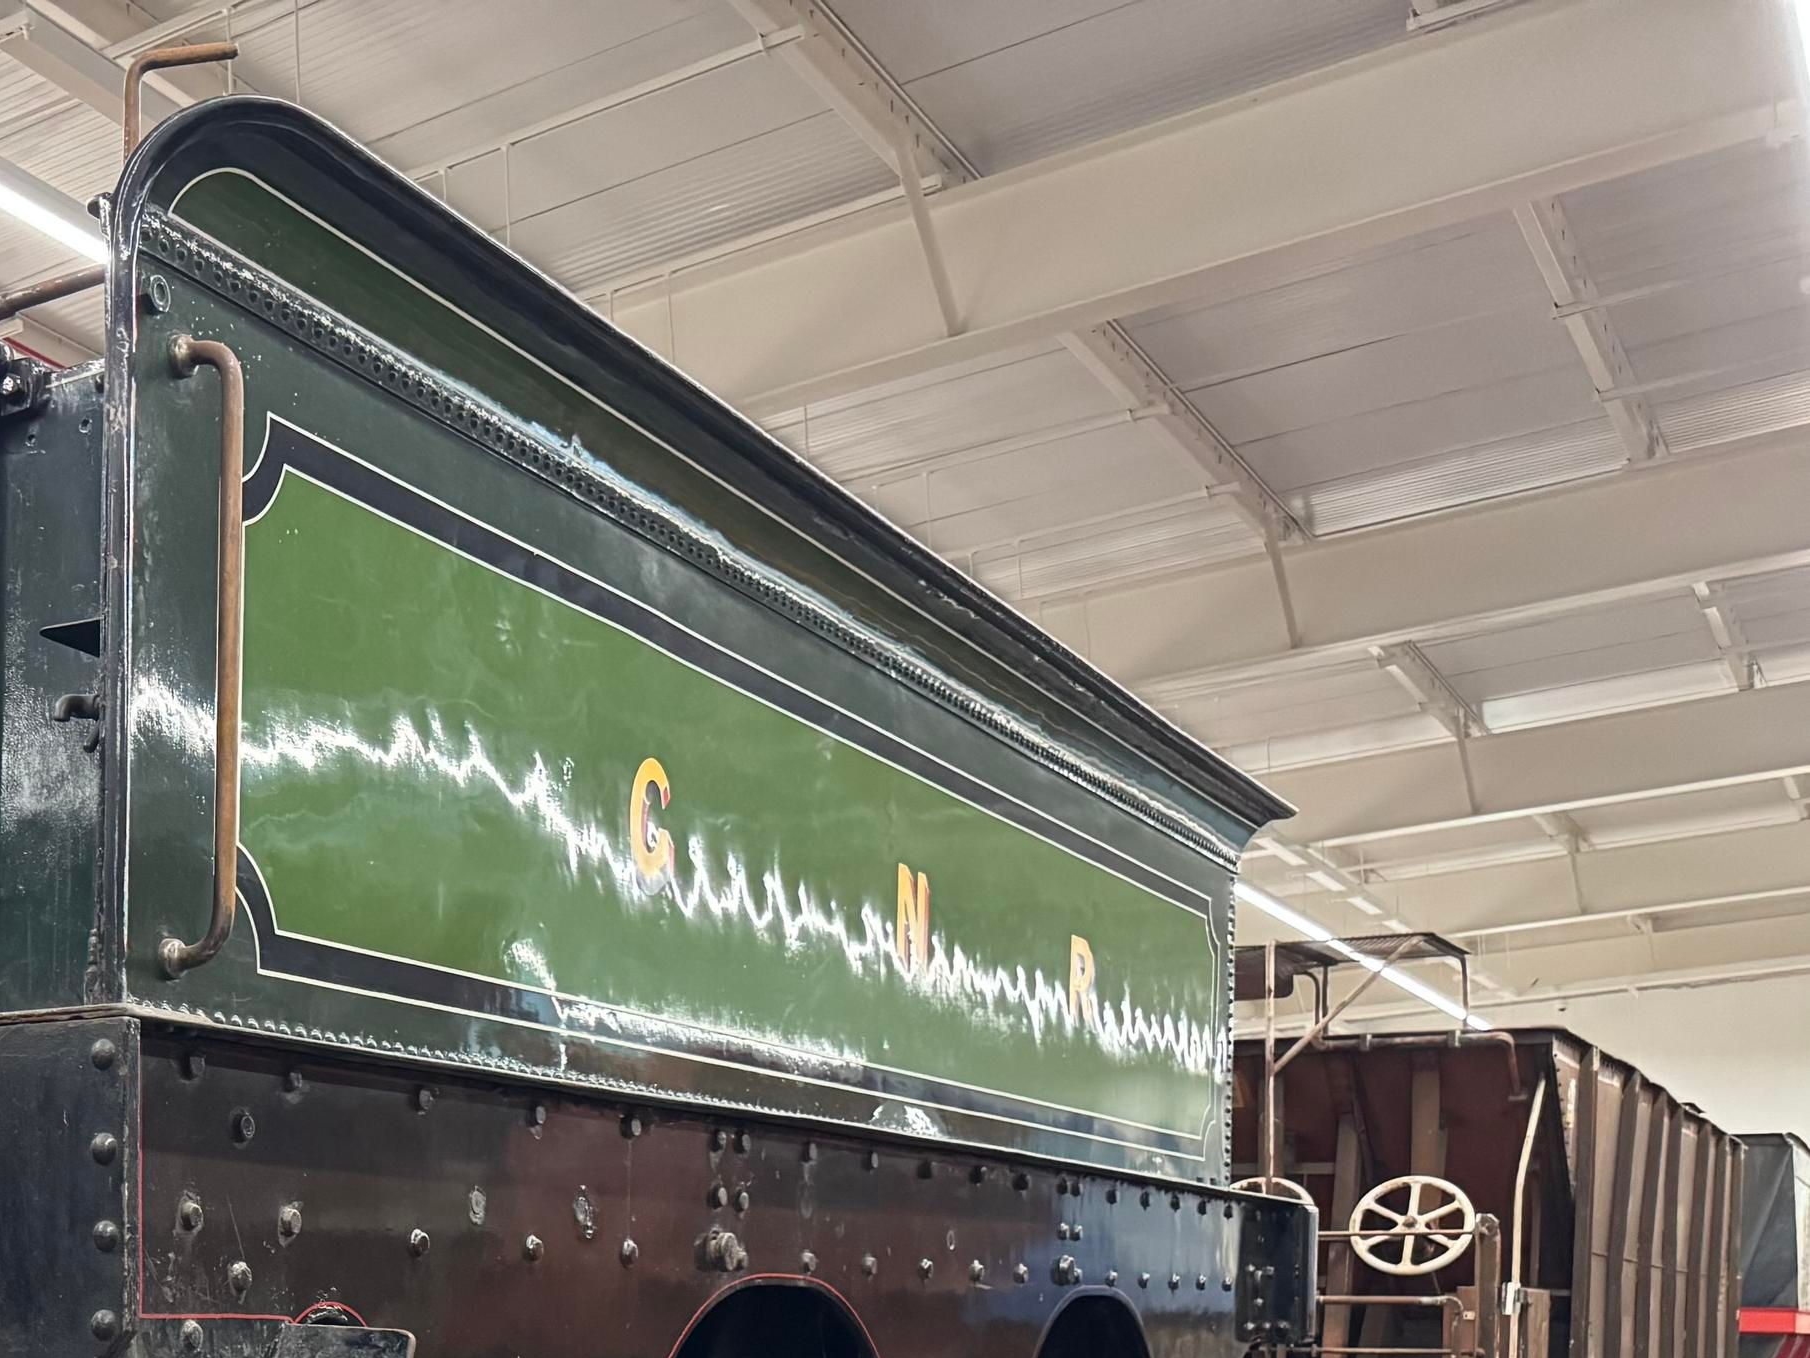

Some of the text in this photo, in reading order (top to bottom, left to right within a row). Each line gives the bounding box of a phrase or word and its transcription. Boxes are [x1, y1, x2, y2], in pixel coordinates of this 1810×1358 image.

[629, 757, 1097, 1034] G N R
